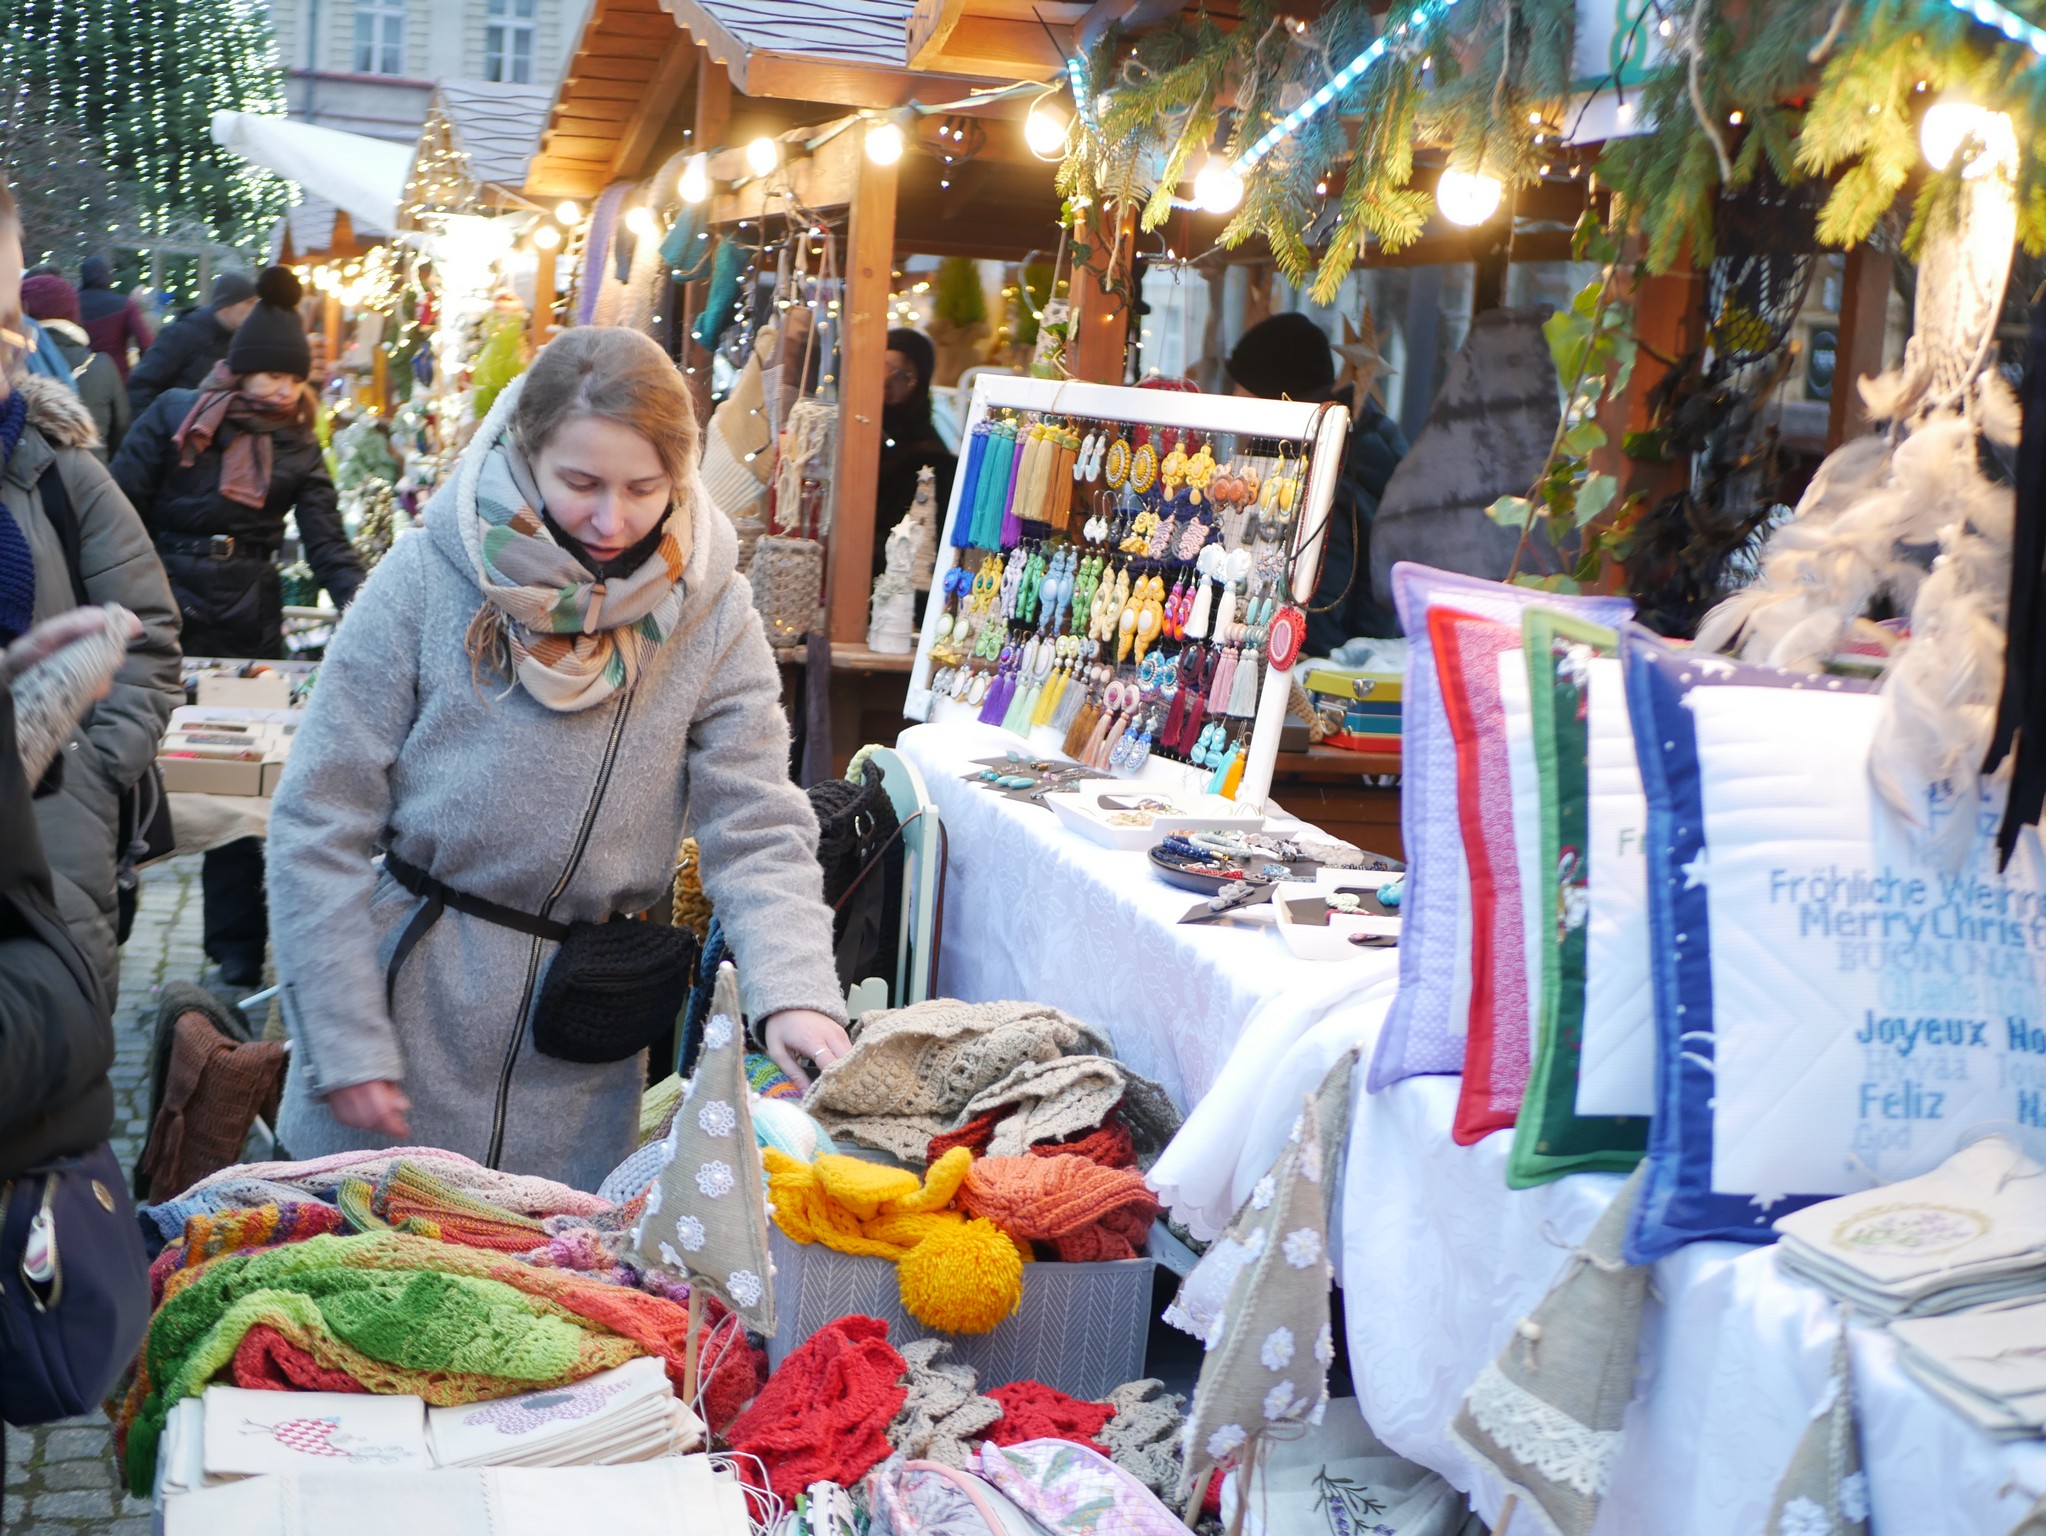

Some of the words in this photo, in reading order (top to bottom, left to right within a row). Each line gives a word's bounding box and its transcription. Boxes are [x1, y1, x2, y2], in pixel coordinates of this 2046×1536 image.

[1800, 903, 1927, 954] Merry
[1857, 1009, 1988, 1057] Joyeux
[1859, 1080, 1946, 1120] Feliz
